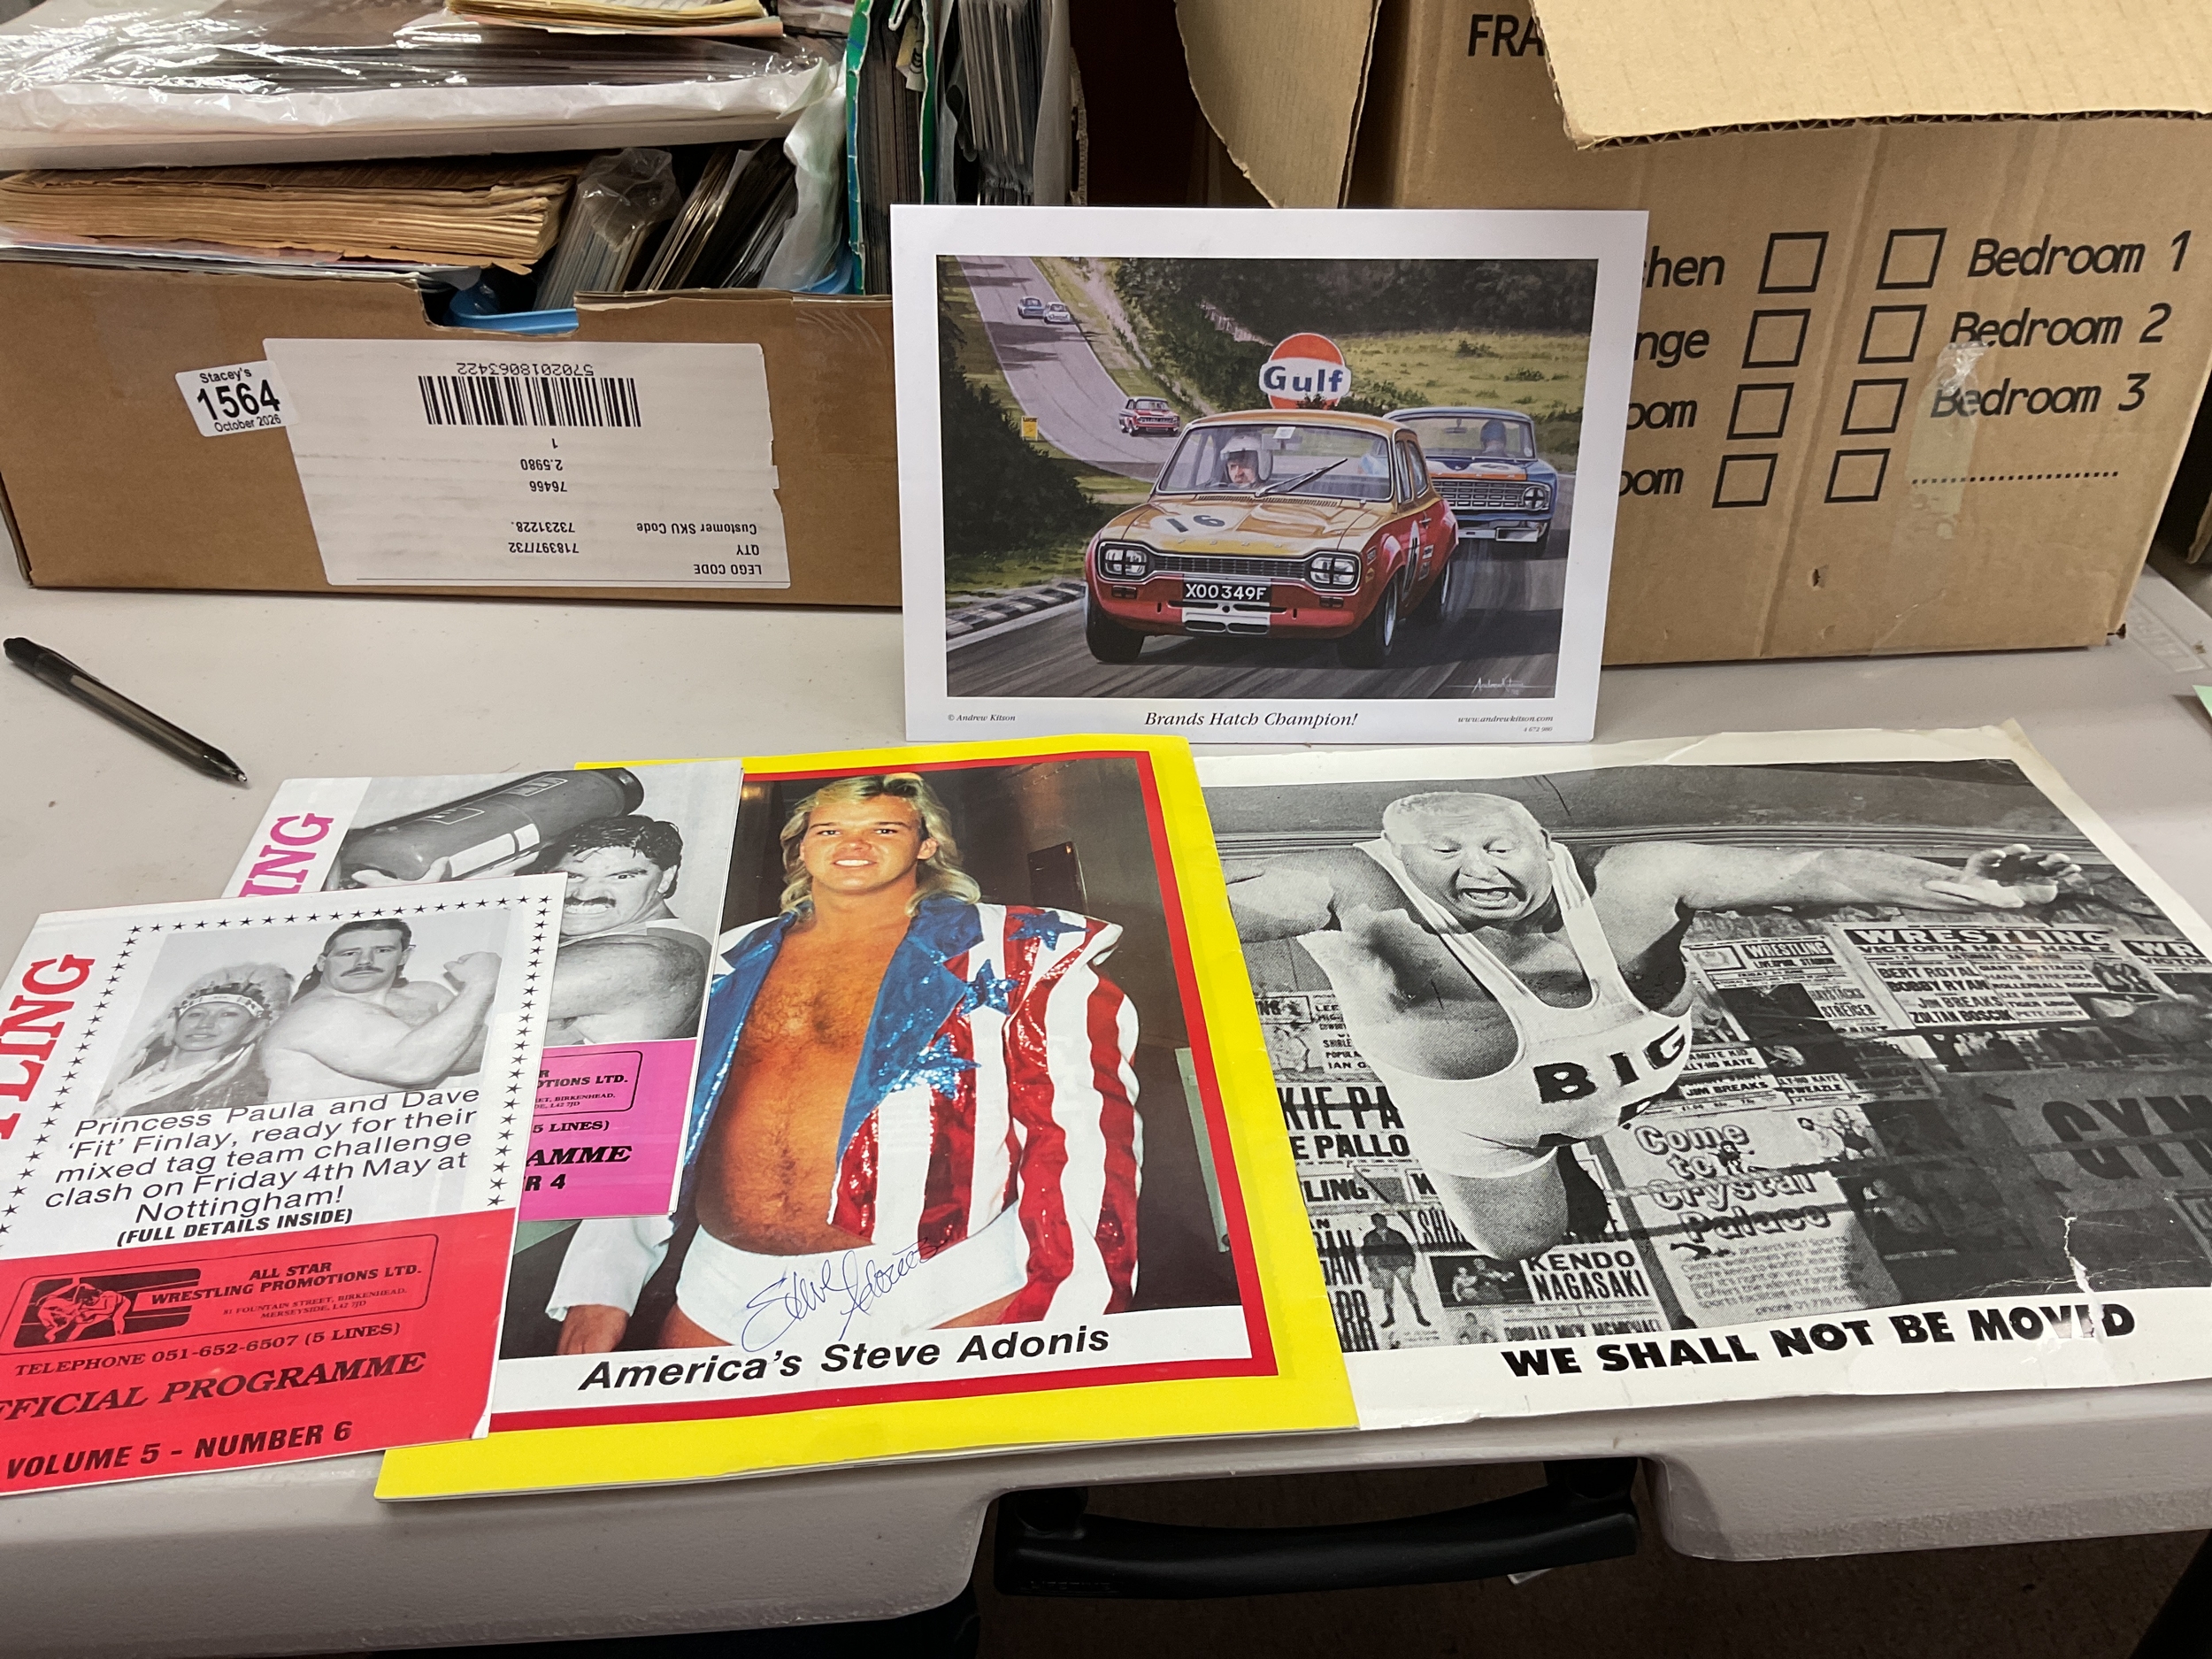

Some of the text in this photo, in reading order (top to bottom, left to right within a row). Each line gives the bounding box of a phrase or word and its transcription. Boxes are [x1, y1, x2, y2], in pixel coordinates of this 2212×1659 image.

[1468, 14, 1545, 57] FRA
[1967, 230, 2192, 277] Bedroom 1
[1642, 245, 1725, 288] hen
[1949, 303, 2172, 349] Bedroom 2
[199, 367, 252, 384] Stacey's
[456, 362, 594, 376] 5702018063422
[1263, 365, 1343, 392] Gulf
[196, 379, 280, 420] 1564
[1930, 373, 2151, 418] Bedroom 3
[214, 413, 281, 433] October 2026
[550, 437, 558, 449] 1
[520, 457, 564, 471] 2.5980
[529, 480, 568, 492] 76466
[636, 522, 757, 535] Customer SKU Code
[1166, 514, 1225, 533] 16
[736, 543, 760, 556] QTY
[693, 563, 762, 576] LEGO CODE
[1144, 712, 1359, 729] Brands Hatch Champion!
[1854, 929, 2111, 944] WRESTLING
[1745, 942, 1830, 958] WRESTLING
[1856, 945, 2038, 954] VICTORIA HALL
[1877, 965, 1980, 979] BERT ROYAL
[1942, 979, 1992, 991] RYAN
[1940, 995, 2004, 1008] BREAKS
[1533, 1025, 1686, 1104] BIG
[595, 1074, 628, 1085] LTD.
[1713, 1081, 1769, 1094] BREAKS
[74, 1089, 480, 1138] Princess Paula and Dave
[133, 1132, 237, 1154] Finlay,
[251, 1120, 342, 1143] ready
[352, 1118, 397, 1134] for
[404, 1108, 478, 1130] their
[549, 1120, 610, 1133] LINES)
[1314, 1133, 1411, 1159] PALLO
[1634, 1125, 1750, 1156] Come
[55, 1133, 472, 1184] mixed tag team challenge
[526, 1145, 633, 1167] AMME
[45, 1152, 470, 1209] clash on Friday 4th May at
[550, 1173, 566, 1190] 4
[1303, 1178, 1371, 1202] LING
[1647, 1172, 1817, 1212] Crystal
[134, 1185, 344, 1224] Nottingham!
[117, 1208, 354, 1248] (FULL DETAILS INSIDE)
[1678, 1205, 1832, 1243] Palace
[249, 1262, 333, 1281] ALL STAR
[1526, 1250, 1636, 1271] KENDO
[151, 1263, 422, 1305] WRESTLING PROMOTIONS LTD.
[1532, 1269, 1650, 1302] NAGASAKI
[235, 1302, 290, 1315] FOUNTAIN
[15, 1322, 401, 1376] TELEPHONE 051-652-6507 (5 LINES)
[1501, 1347, 1582, 1378] WE
[1597, 1334, 1760, 1372] SHALL
[1770, 1319, 1886, 1359] NOT
[1888, 1311, 1956, 1344] BE
[577, 1325, 1110, 1392] America's Steve Adonis
[157, 1352, 427, 1404] PROGRAMME
[7, 1446, 134, 1480] VOLUME
[140, 1443, 161, 1464] 5
[195, 1424, 325, 1459] NUMBER
[333, 1421, 353, 1442] 6
